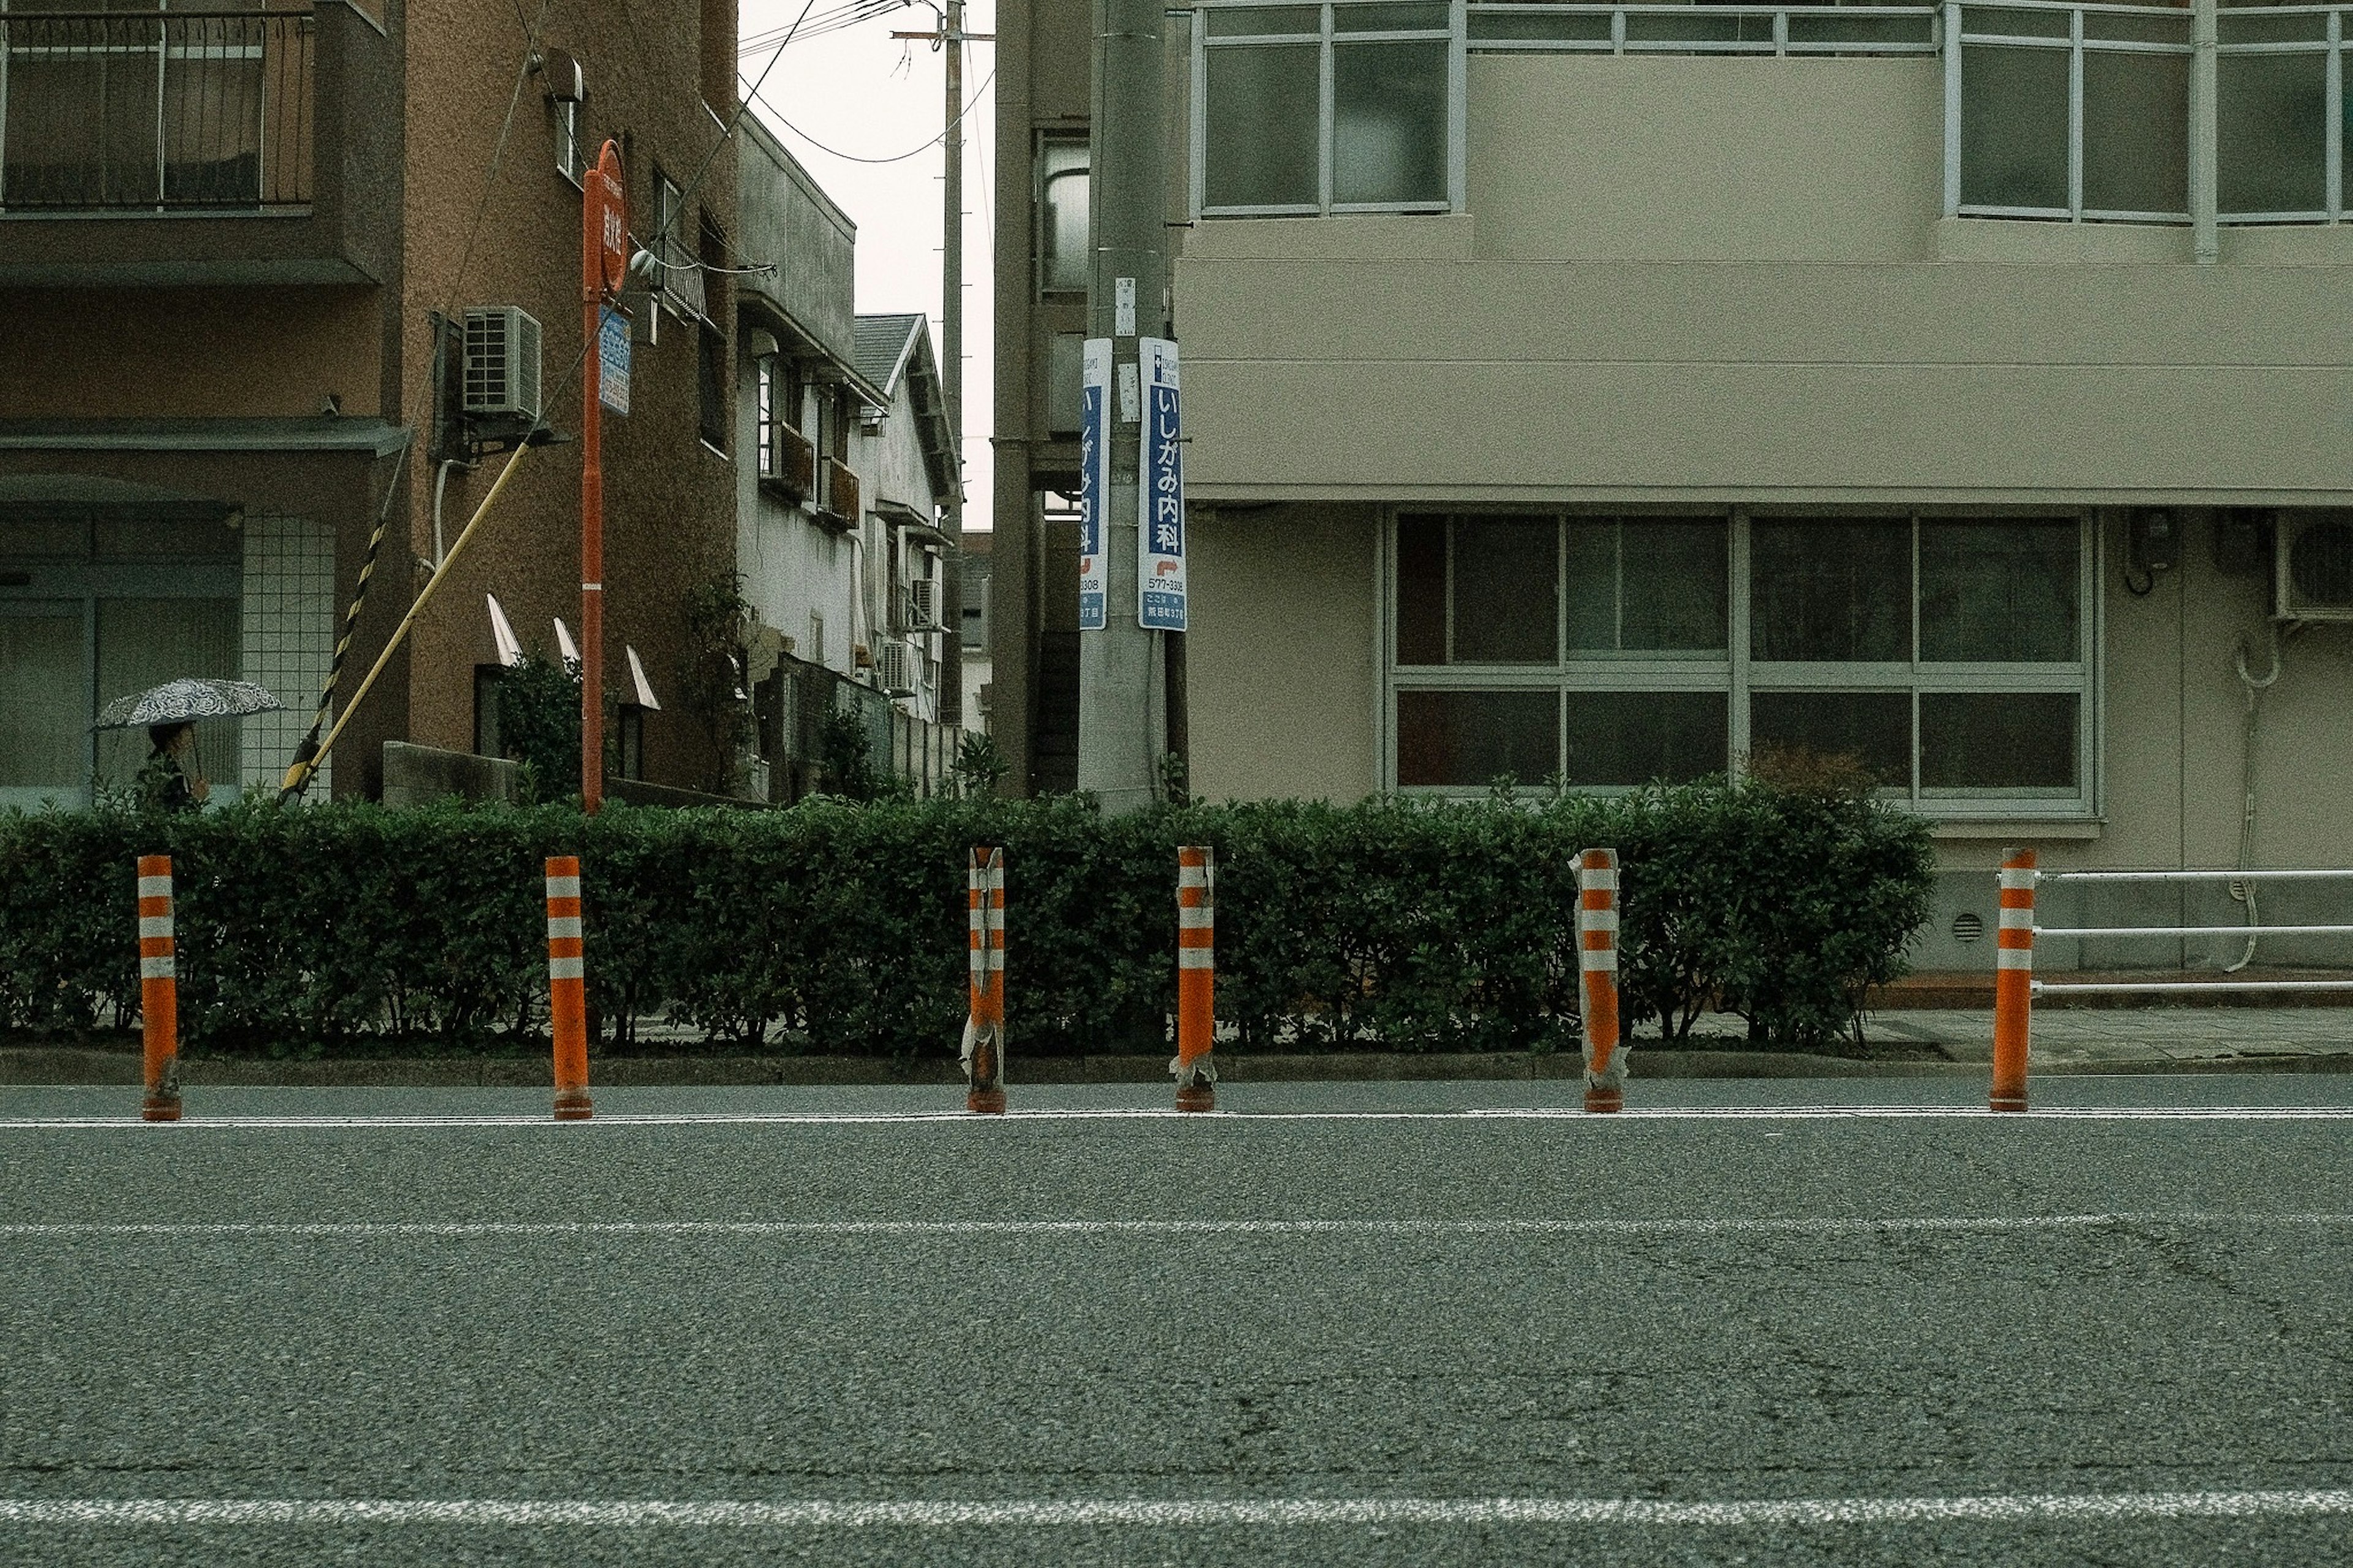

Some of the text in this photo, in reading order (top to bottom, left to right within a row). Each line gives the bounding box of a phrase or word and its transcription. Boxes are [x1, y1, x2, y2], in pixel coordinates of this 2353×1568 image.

[1156, 388, 1179, 554] いしがみ内科
